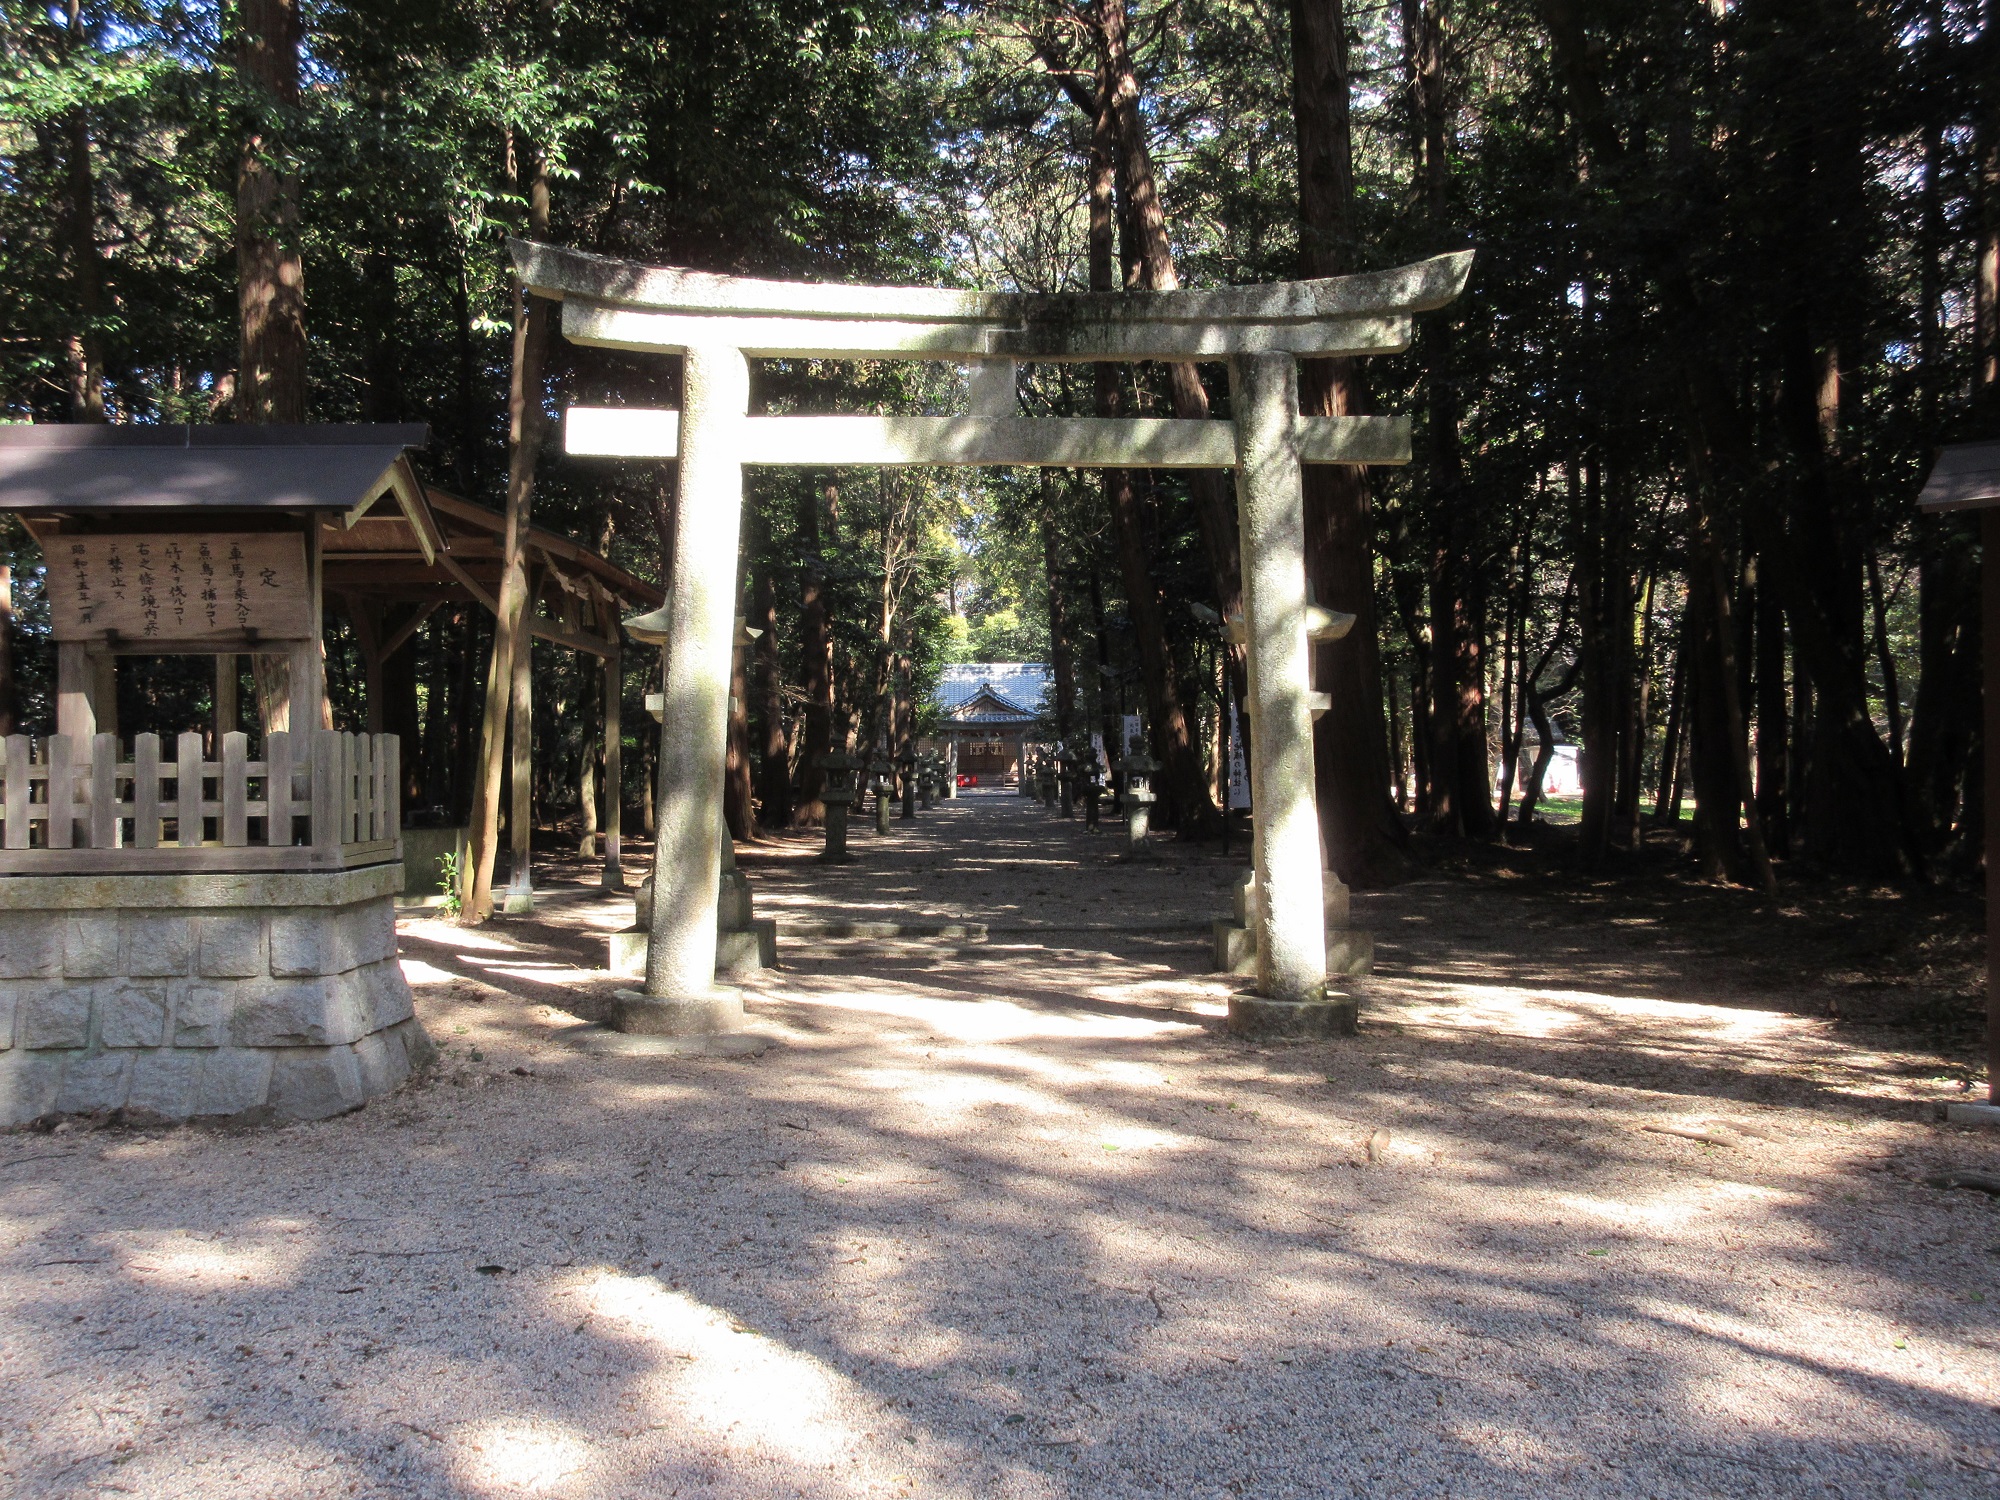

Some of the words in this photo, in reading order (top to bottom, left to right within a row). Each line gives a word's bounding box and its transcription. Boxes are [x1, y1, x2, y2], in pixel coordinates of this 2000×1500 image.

[71, 544, 94, 624] 昭和十五年一月
[260, 568, 280, 588] 定
